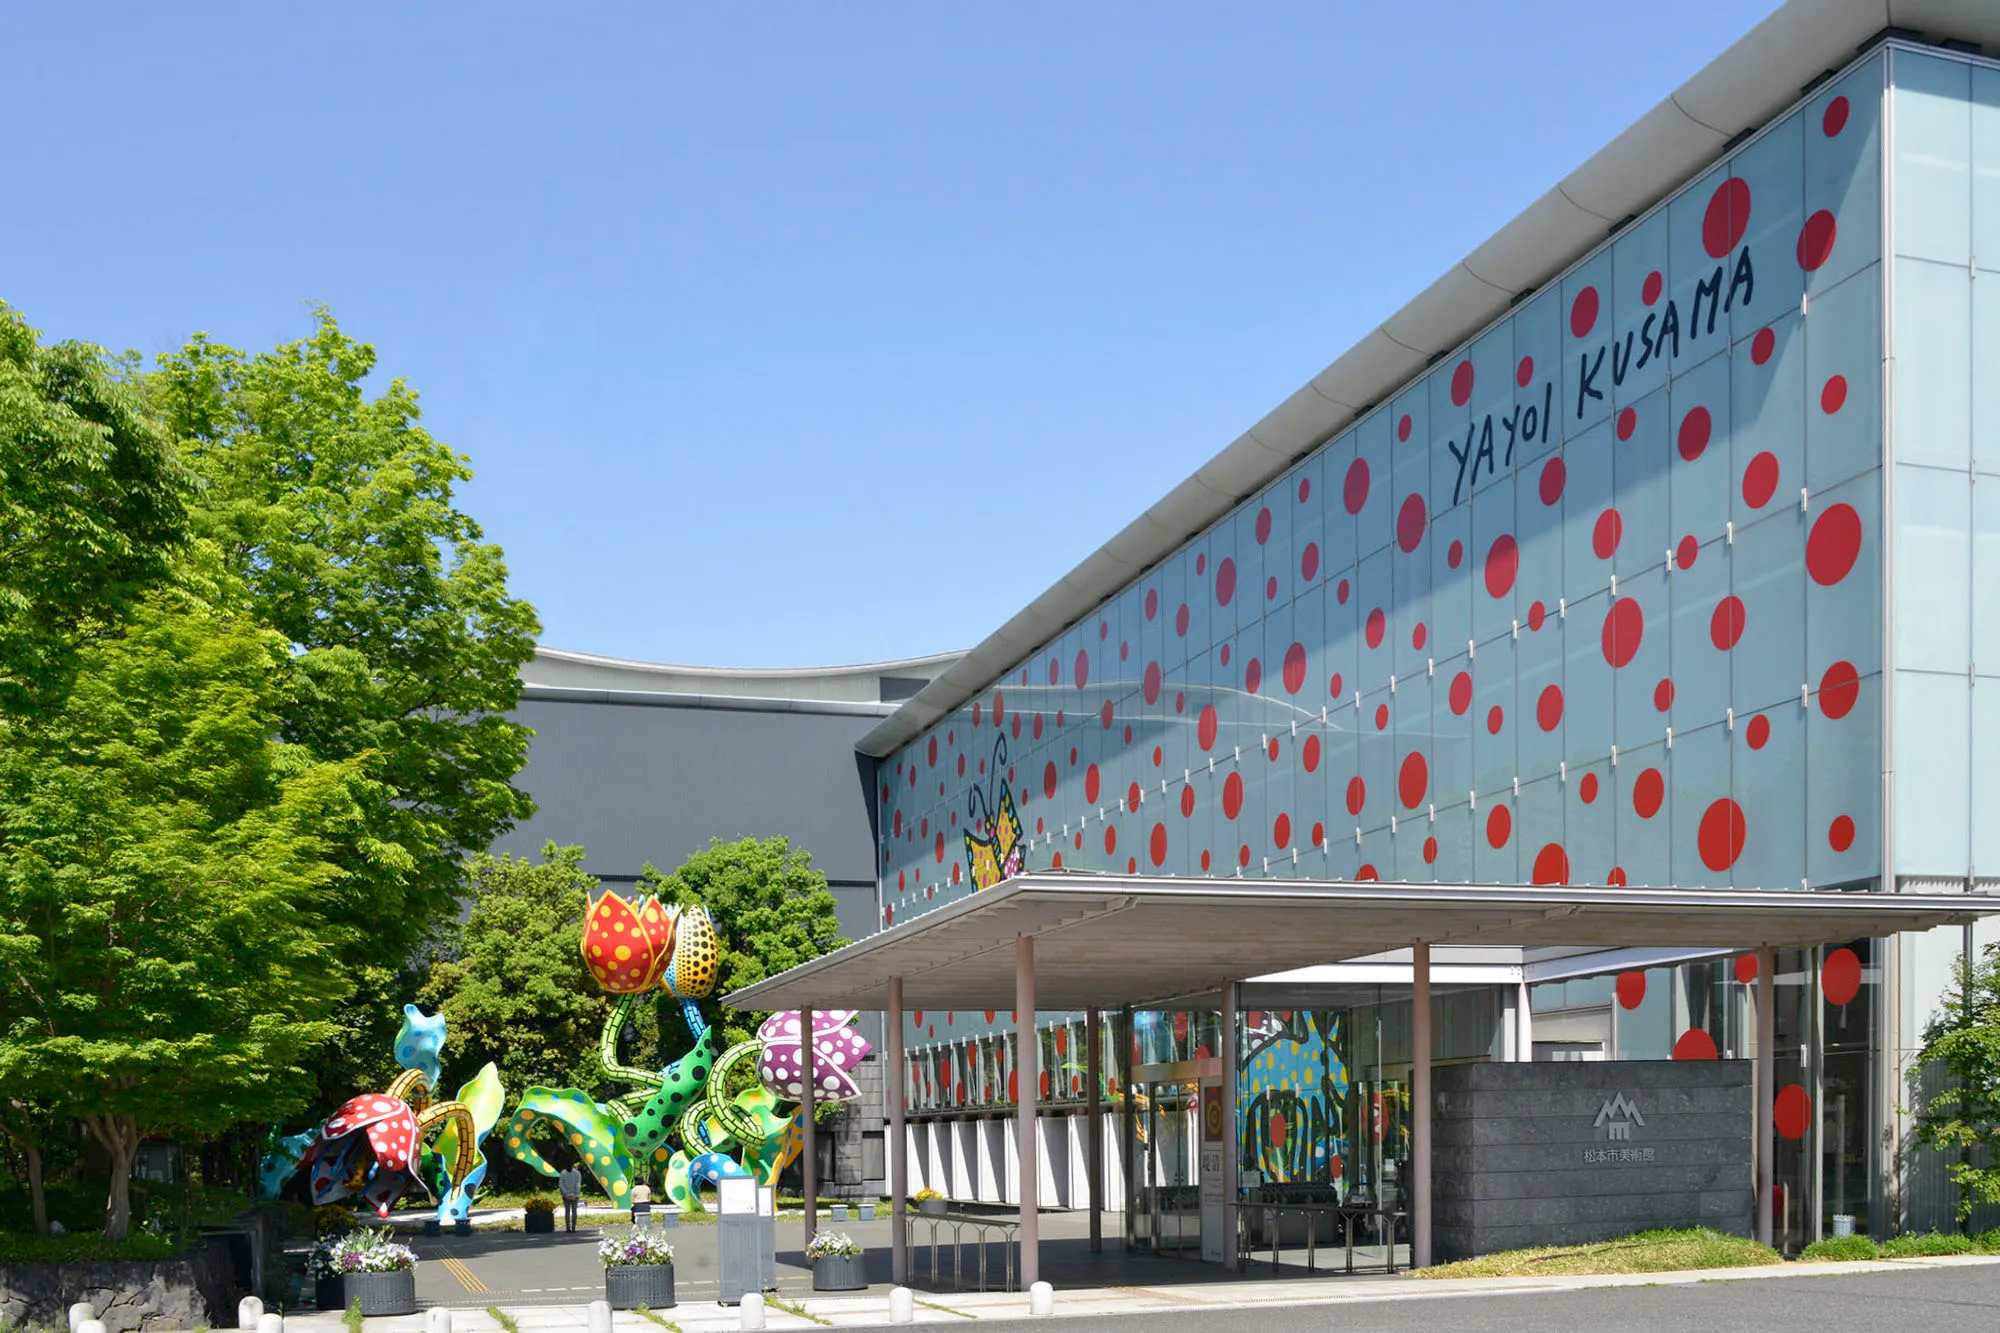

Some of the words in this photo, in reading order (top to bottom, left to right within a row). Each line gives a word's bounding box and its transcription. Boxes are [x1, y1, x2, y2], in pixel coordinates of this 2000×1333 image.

[1448, 382, 1552, 506] YAYOI
[1577, 245, 1754, 419] KUSAMA
[1584, 1147, 1655, 1163] 松本市美術館
